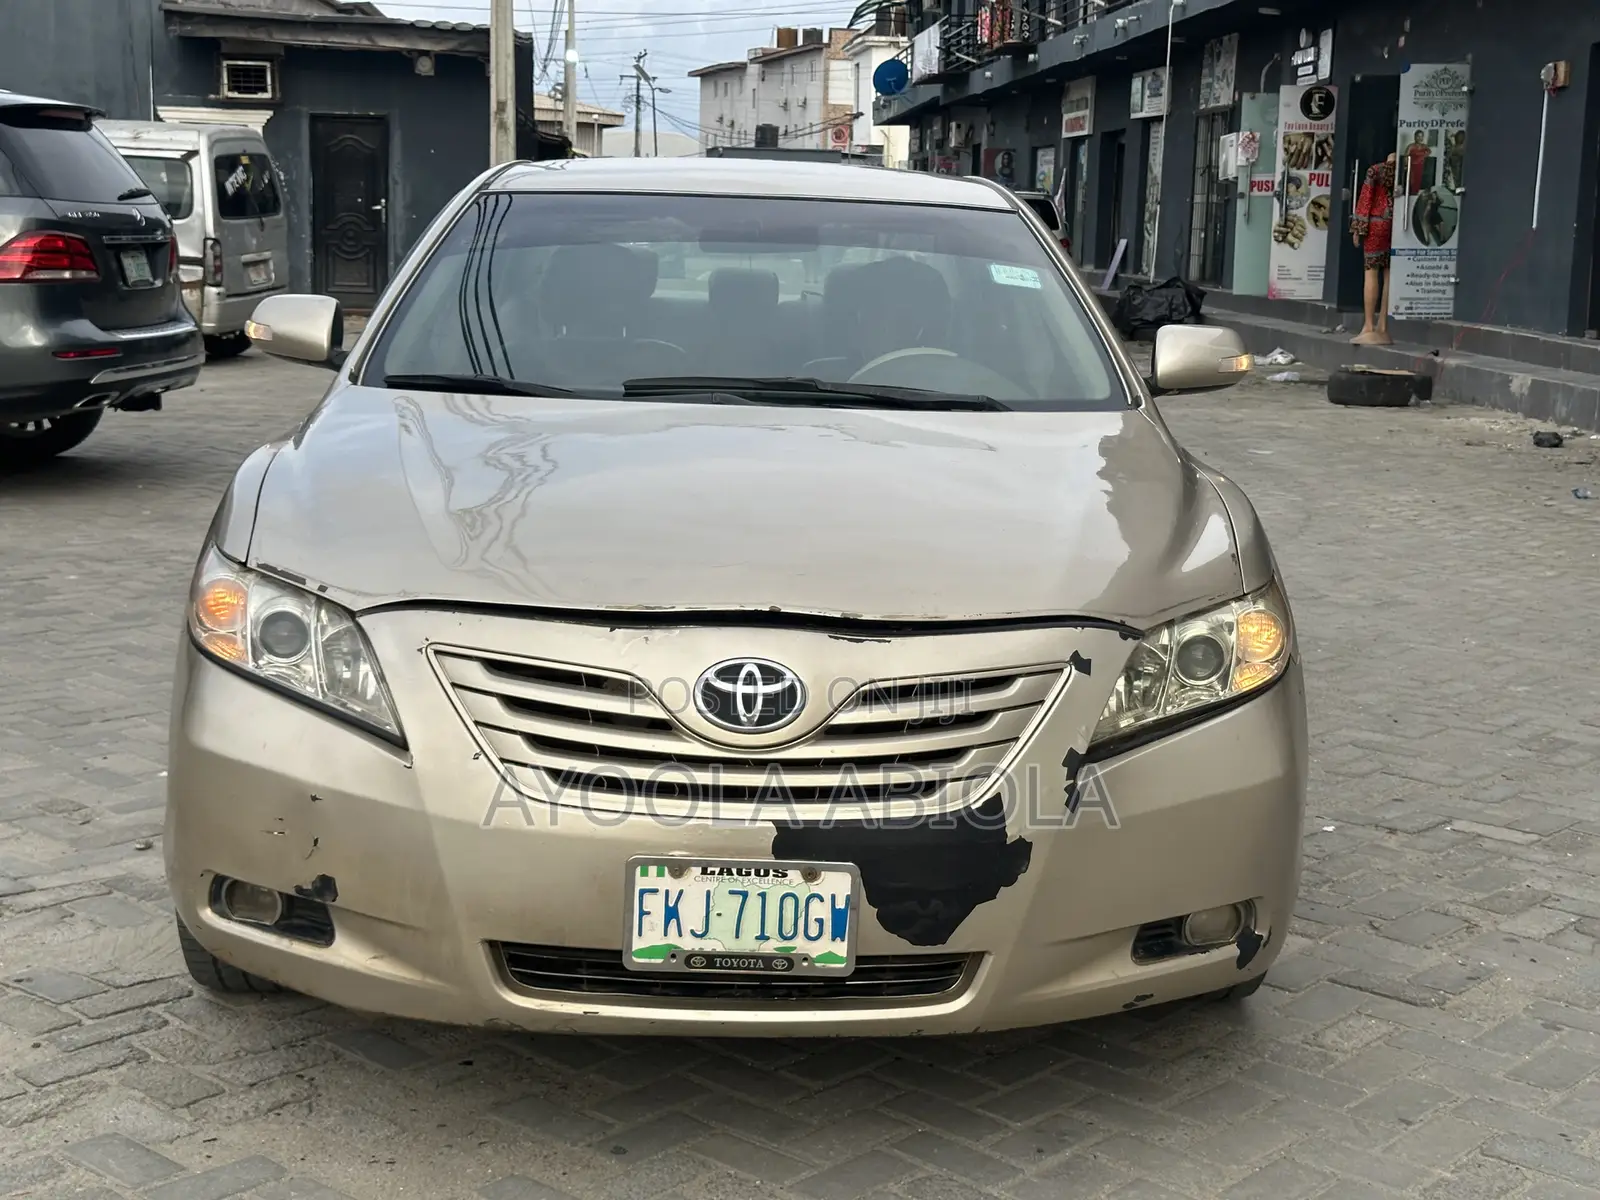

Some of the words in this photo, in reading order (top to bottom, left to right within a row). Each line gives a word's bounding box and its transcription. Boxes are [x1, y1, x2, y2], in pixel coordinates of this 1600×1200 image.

[700, 867, 788, 878] LAGOS
[728, 876, 740, 884] OF
[741, 877, 794, 886] EXCELLENCE
[714, 958, 765, 969] TOYOTA
